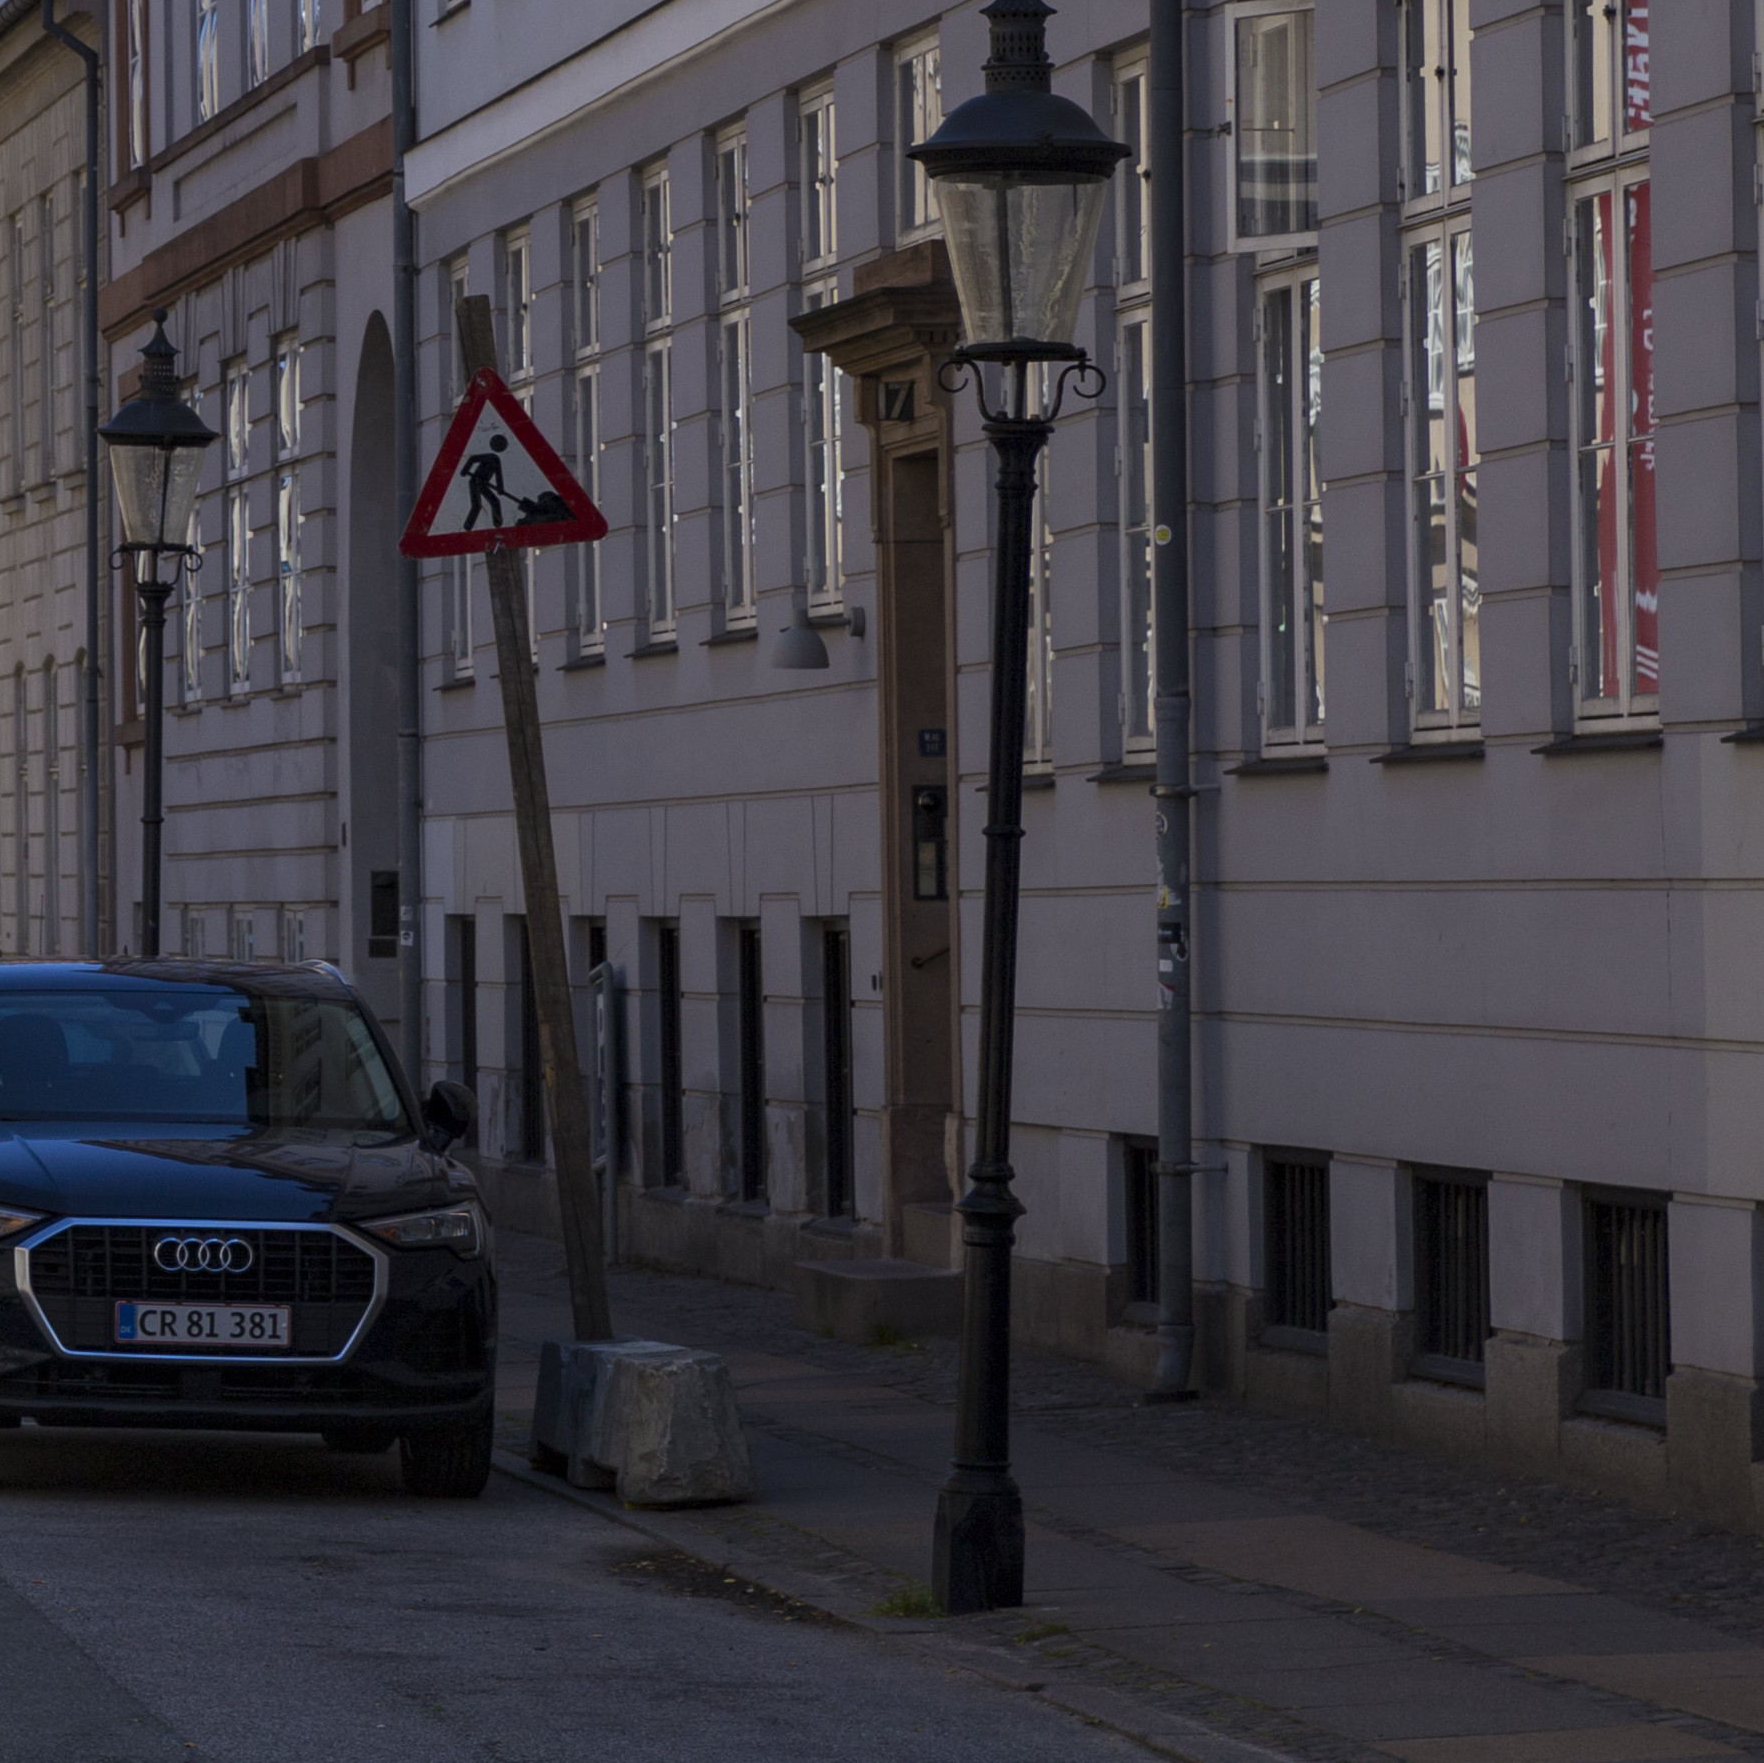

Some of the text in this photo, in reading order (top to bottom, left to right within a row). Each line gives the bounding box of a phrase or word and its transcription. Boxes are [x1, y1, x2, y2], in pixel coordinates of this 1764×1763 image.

[877, 381, 911, 420] 17
[139, 1309, 282, 1340] CR 81 381
